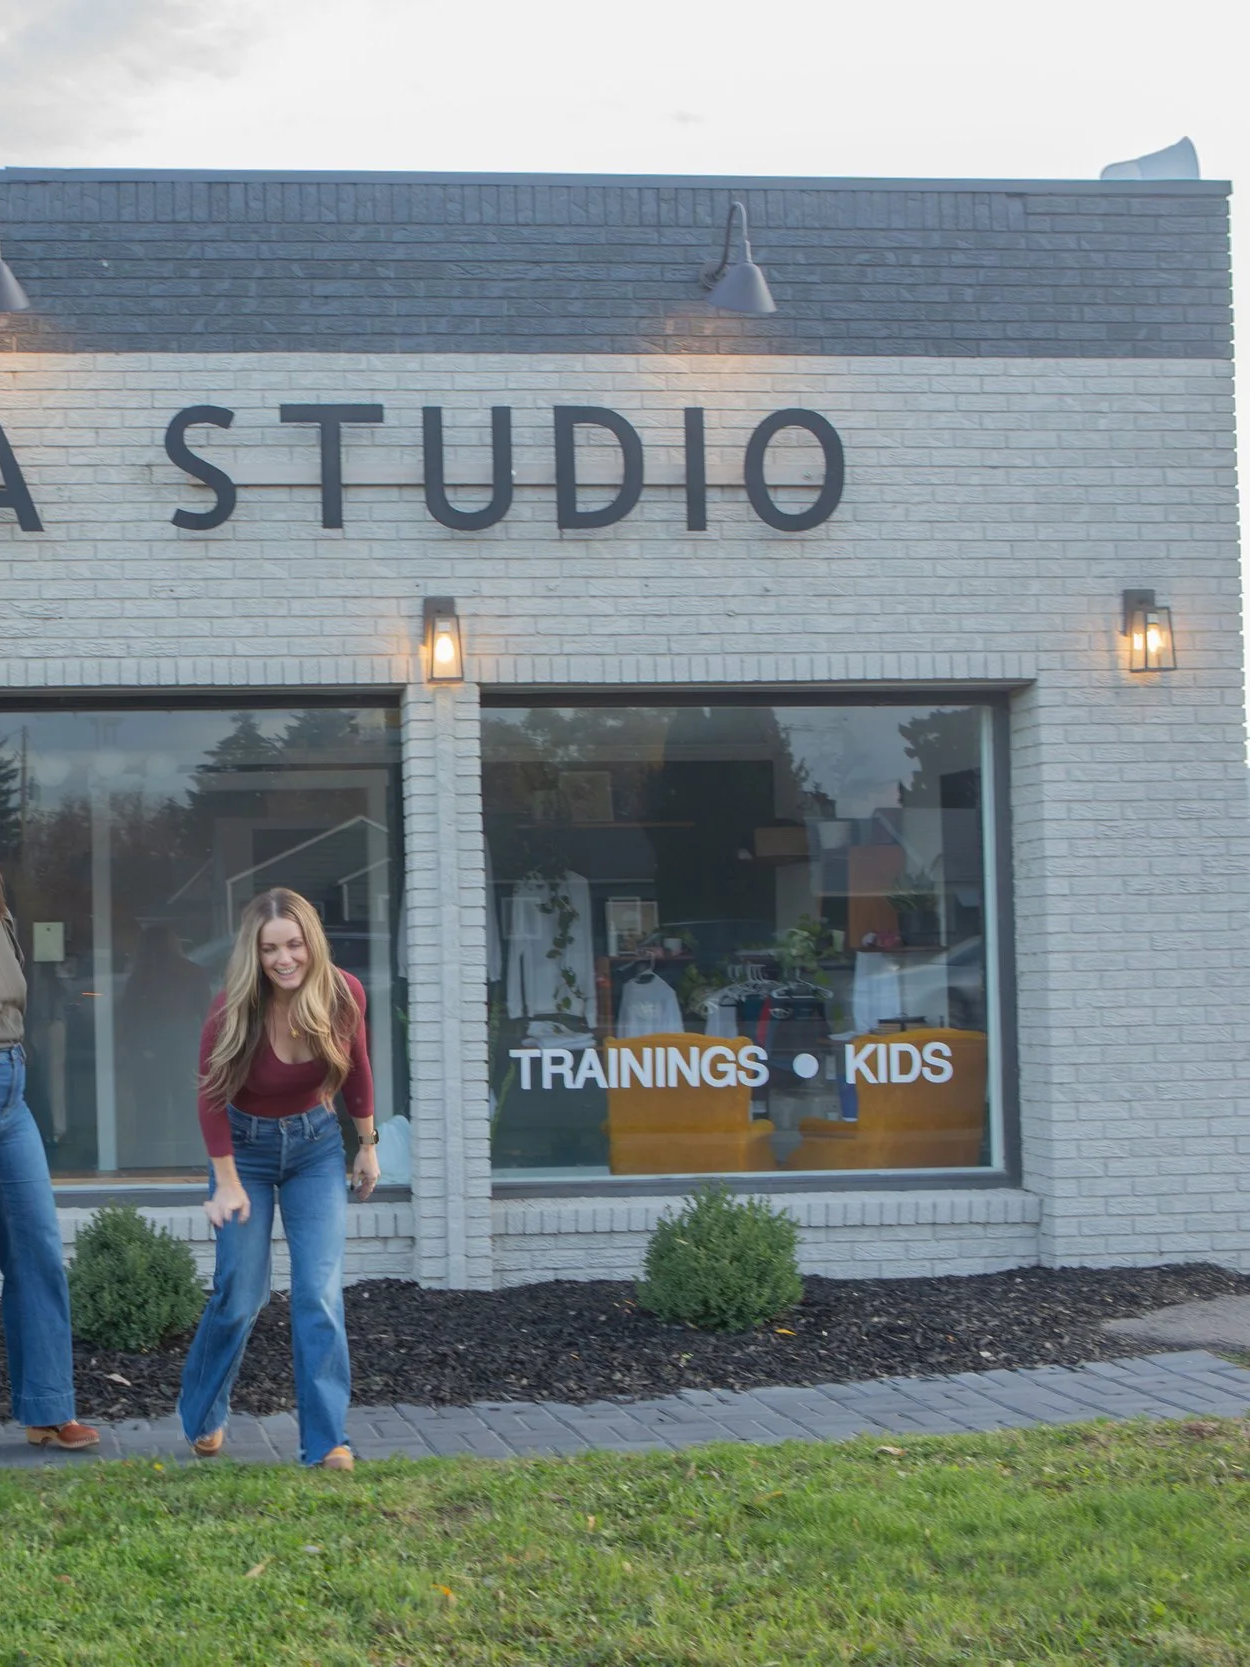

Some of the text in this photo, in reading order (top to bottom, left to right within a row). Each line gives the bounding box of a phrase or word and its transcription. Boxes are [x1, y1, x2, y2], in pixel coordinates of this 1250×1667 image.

[164, 402, 845, 532] STUDIO
[509, 1042, 954, 1090] TRAININGS KIDS
